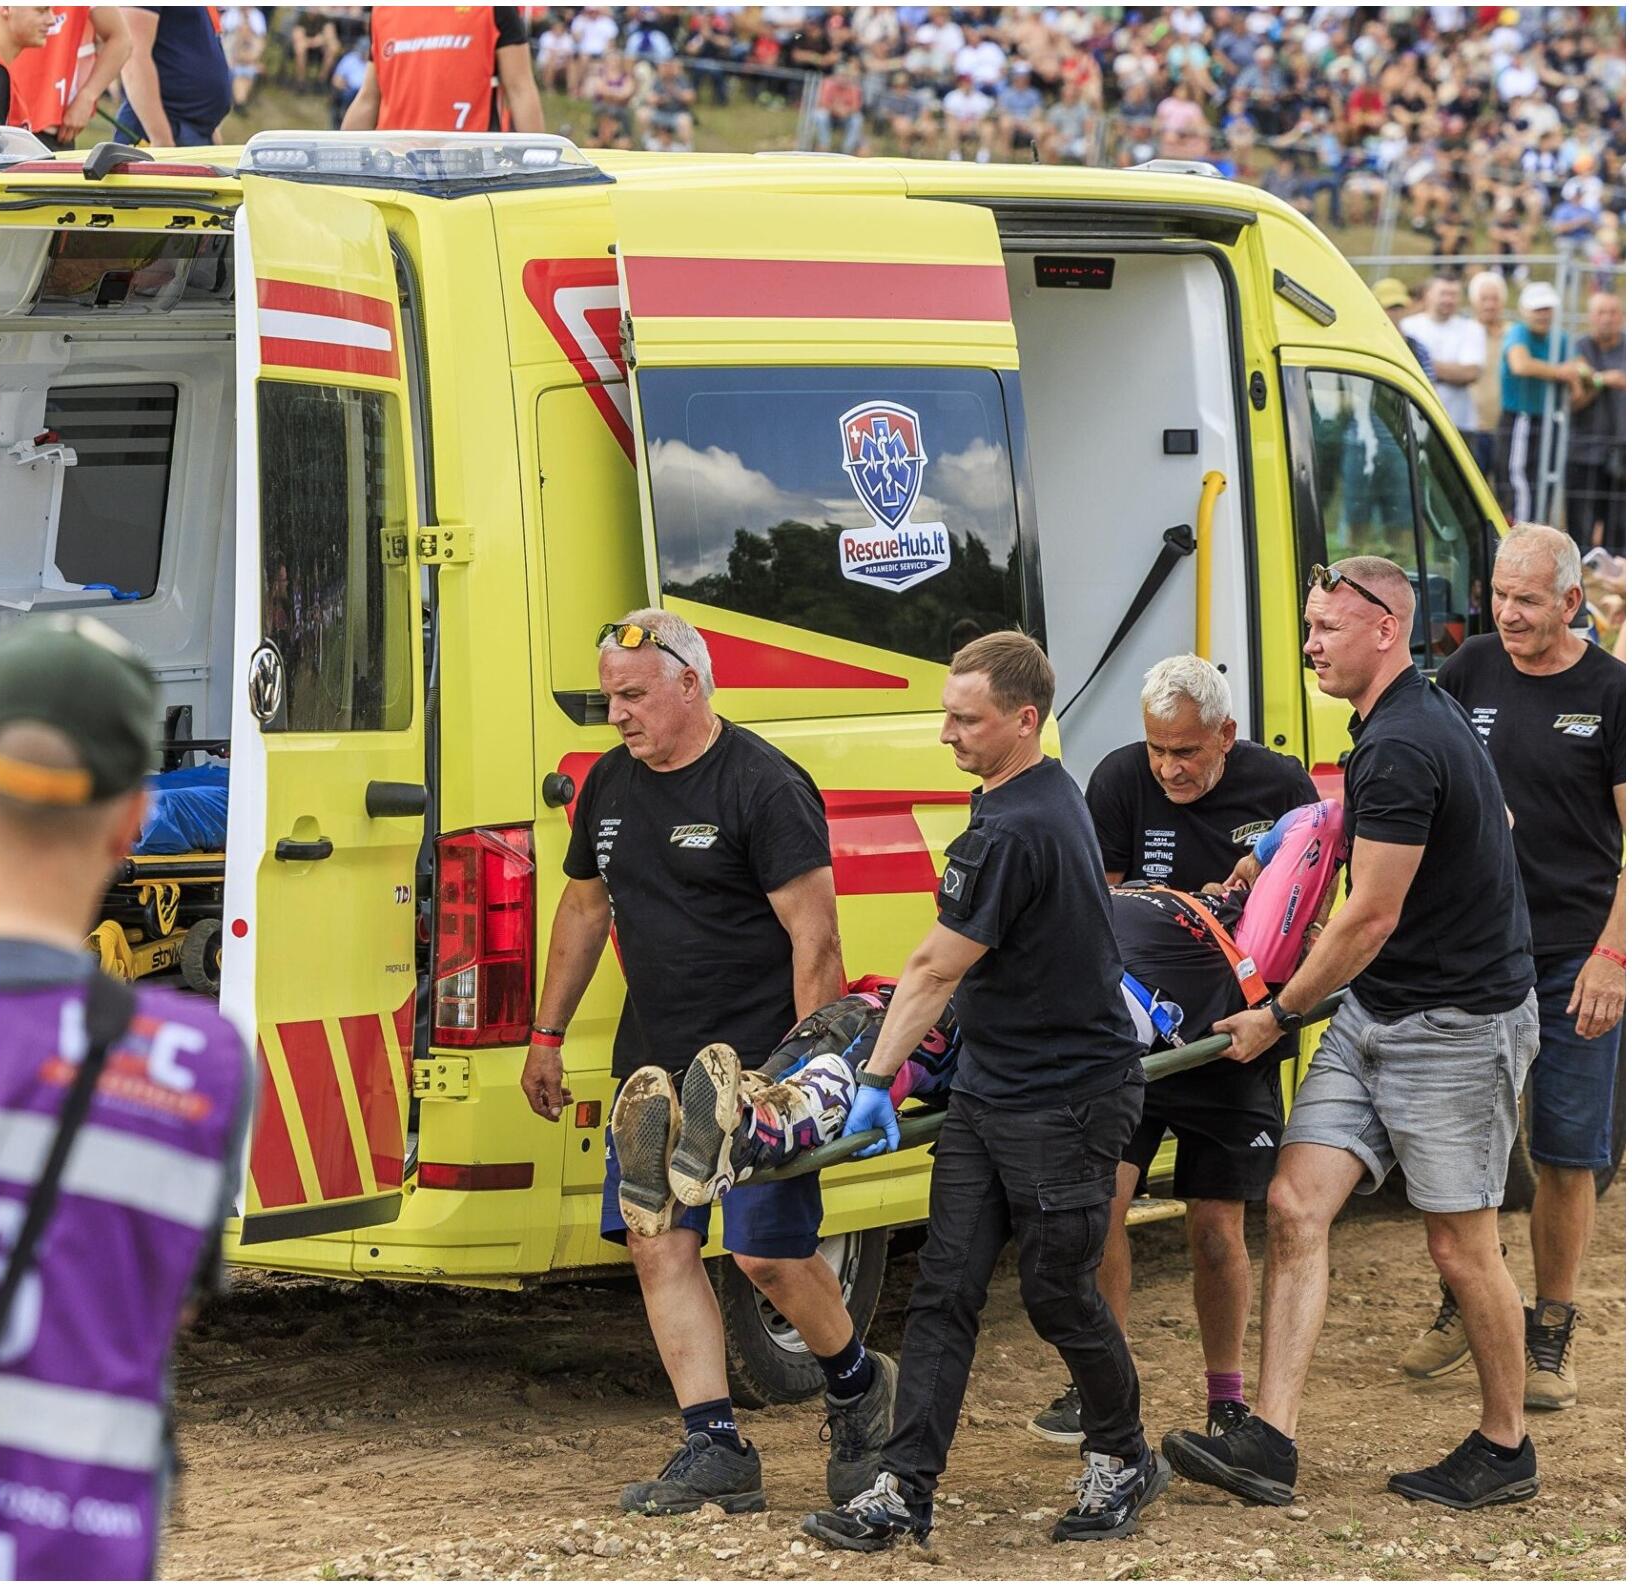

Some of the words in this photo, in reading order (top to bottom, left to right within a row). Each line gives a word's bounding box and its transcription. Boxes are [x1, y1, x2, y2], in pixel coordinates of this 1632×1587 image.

[55, 79, 66, 105] 1
[453, 102, 471, 129] 7
[843, 531, 945, 563] RescueHub.lt
[865, 565, 898, 574] PARAMEDIC
[900, 561, 927, 570] SERVICES
[1144, 851, 1173, 861] WHITING
